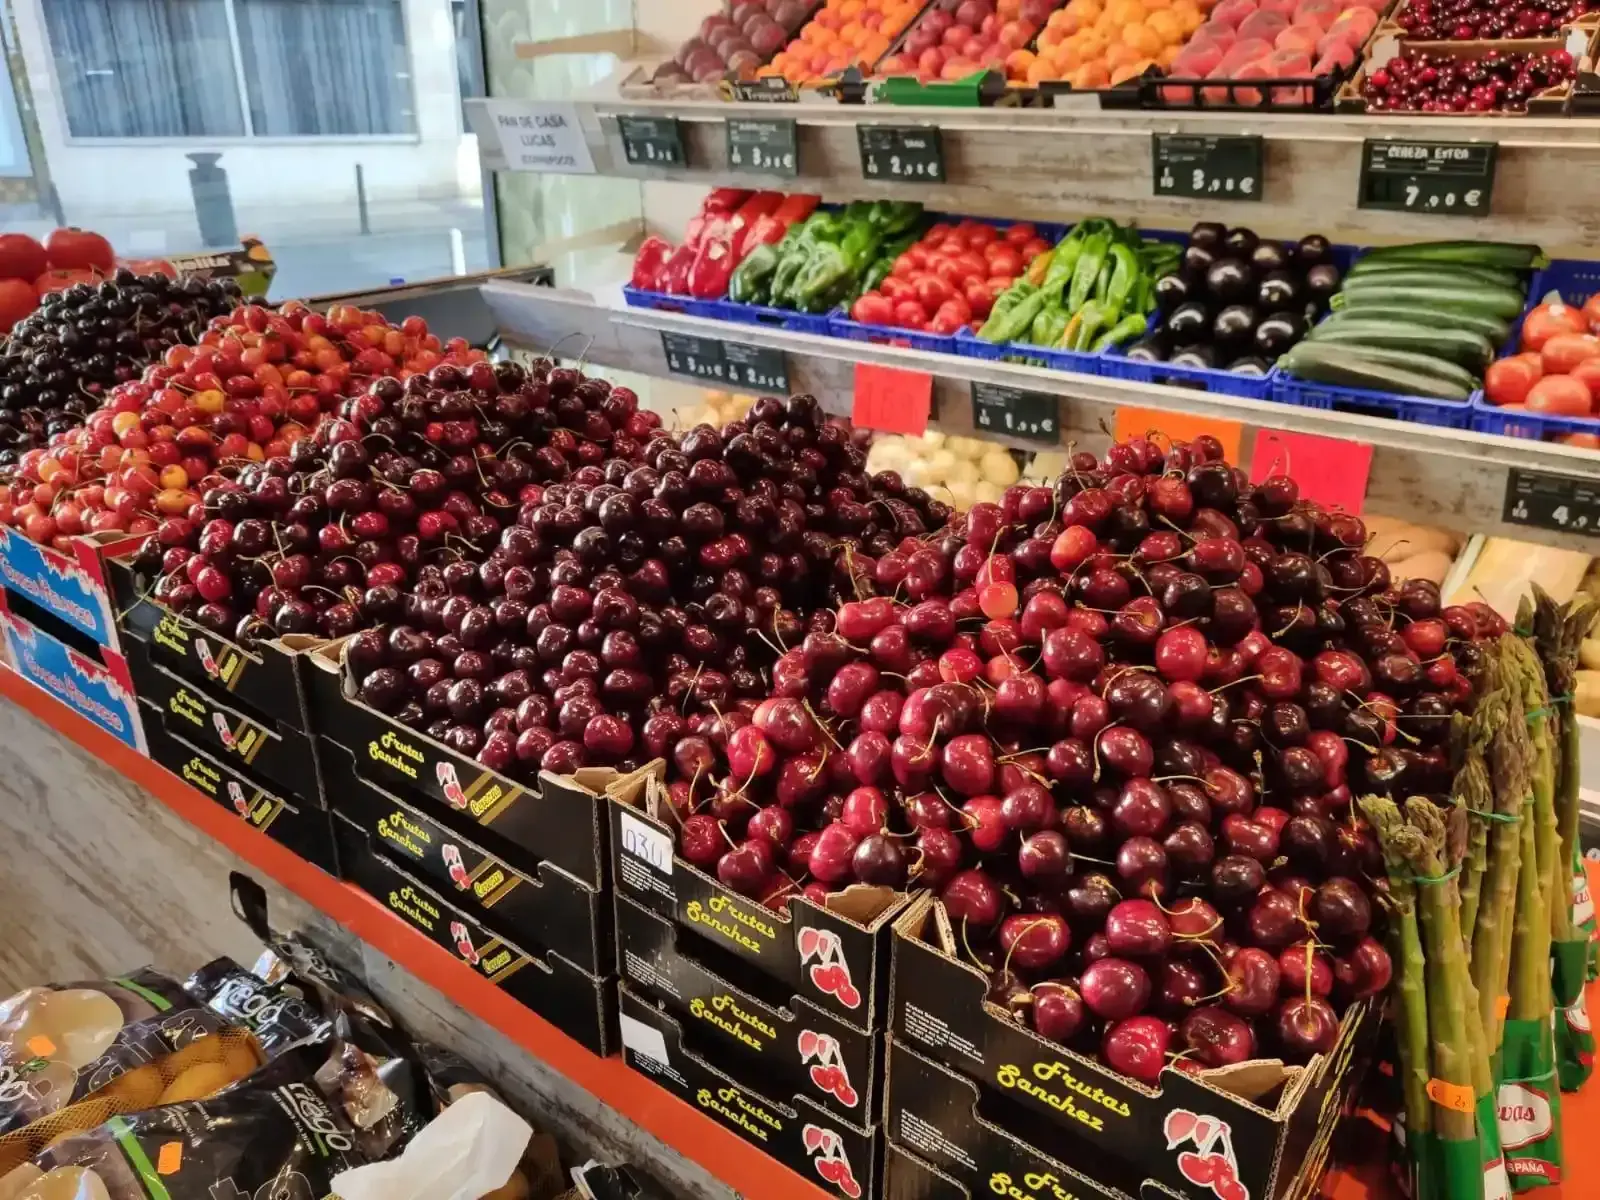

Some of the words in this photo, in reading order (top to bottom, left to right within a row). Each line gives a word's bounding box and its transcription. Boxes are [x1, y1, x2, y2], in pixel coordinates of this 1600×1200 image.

[368, 741, 418, 780] Sanchez
[380, 731, 425, 763] Frutas
[377, 818, 424, 858] Sanchez
[389, 811, 431, 844] Frutas
[388, 891, 434, 932] Sanchez
[400, 885, 441, 920] Frutas
[708, 895, 775, 939] Frutas
[686, 900, 761, 954] Sanchez
[689, 997, 763, 1052] Sanchez
[711, 994, 777, 1039] Frutas
[718, 1087, 783, 1132] Frutas
[996, 1063, 1104, 1132] Sanchez
[1032, 1060, 1131, 1117] Frutas
[696, 1088, 769, 1142] Sanchez
